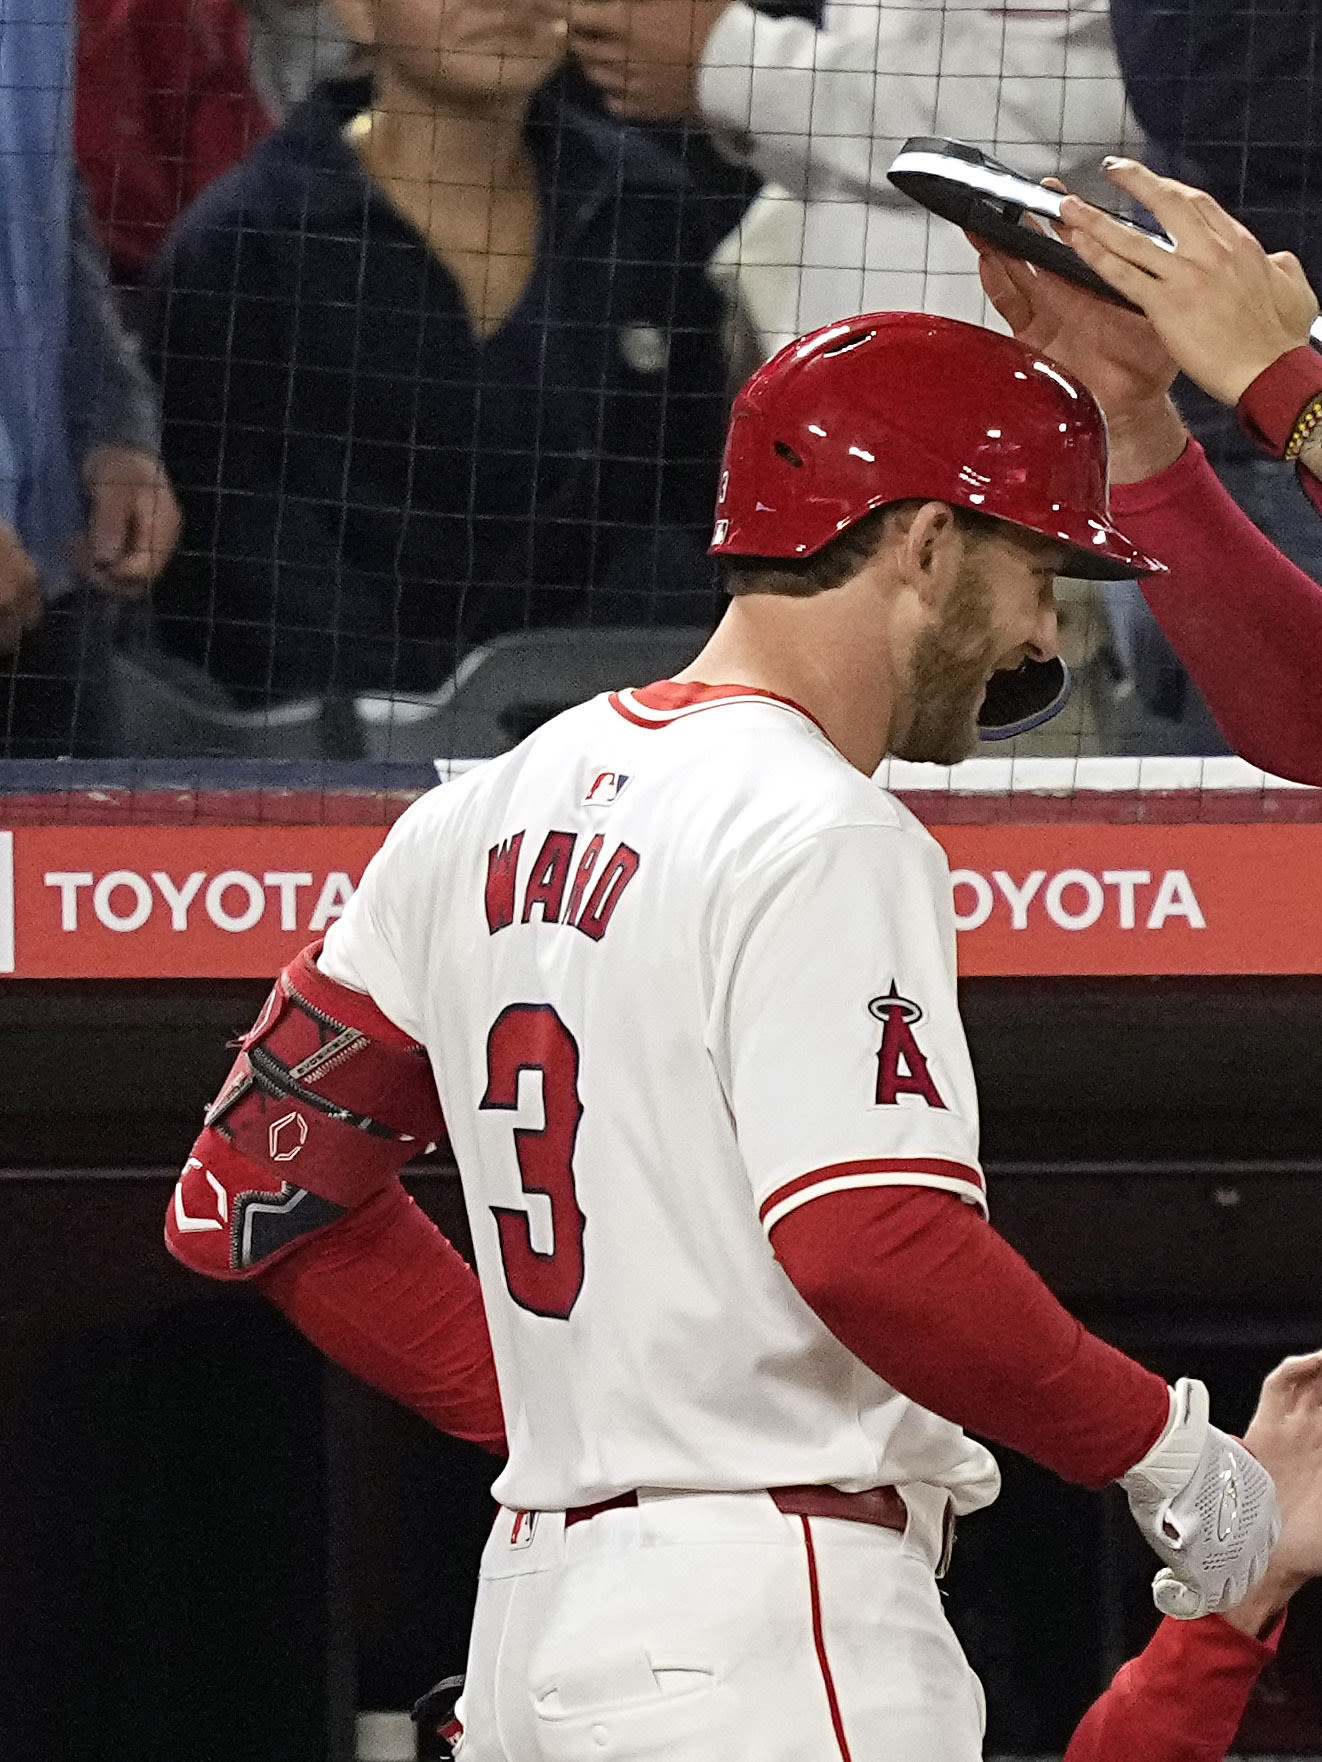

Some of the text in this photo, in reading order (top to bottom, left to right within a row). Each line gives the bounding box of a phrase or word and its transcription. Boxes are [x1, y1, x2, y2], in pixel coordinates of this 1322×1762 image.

[44, 870, 358, 932] TOYOTA
[485, 829, 641, 942] WARD
[868, 976, 950, 1111] A
[478, 1001, 586, 1321] 3
